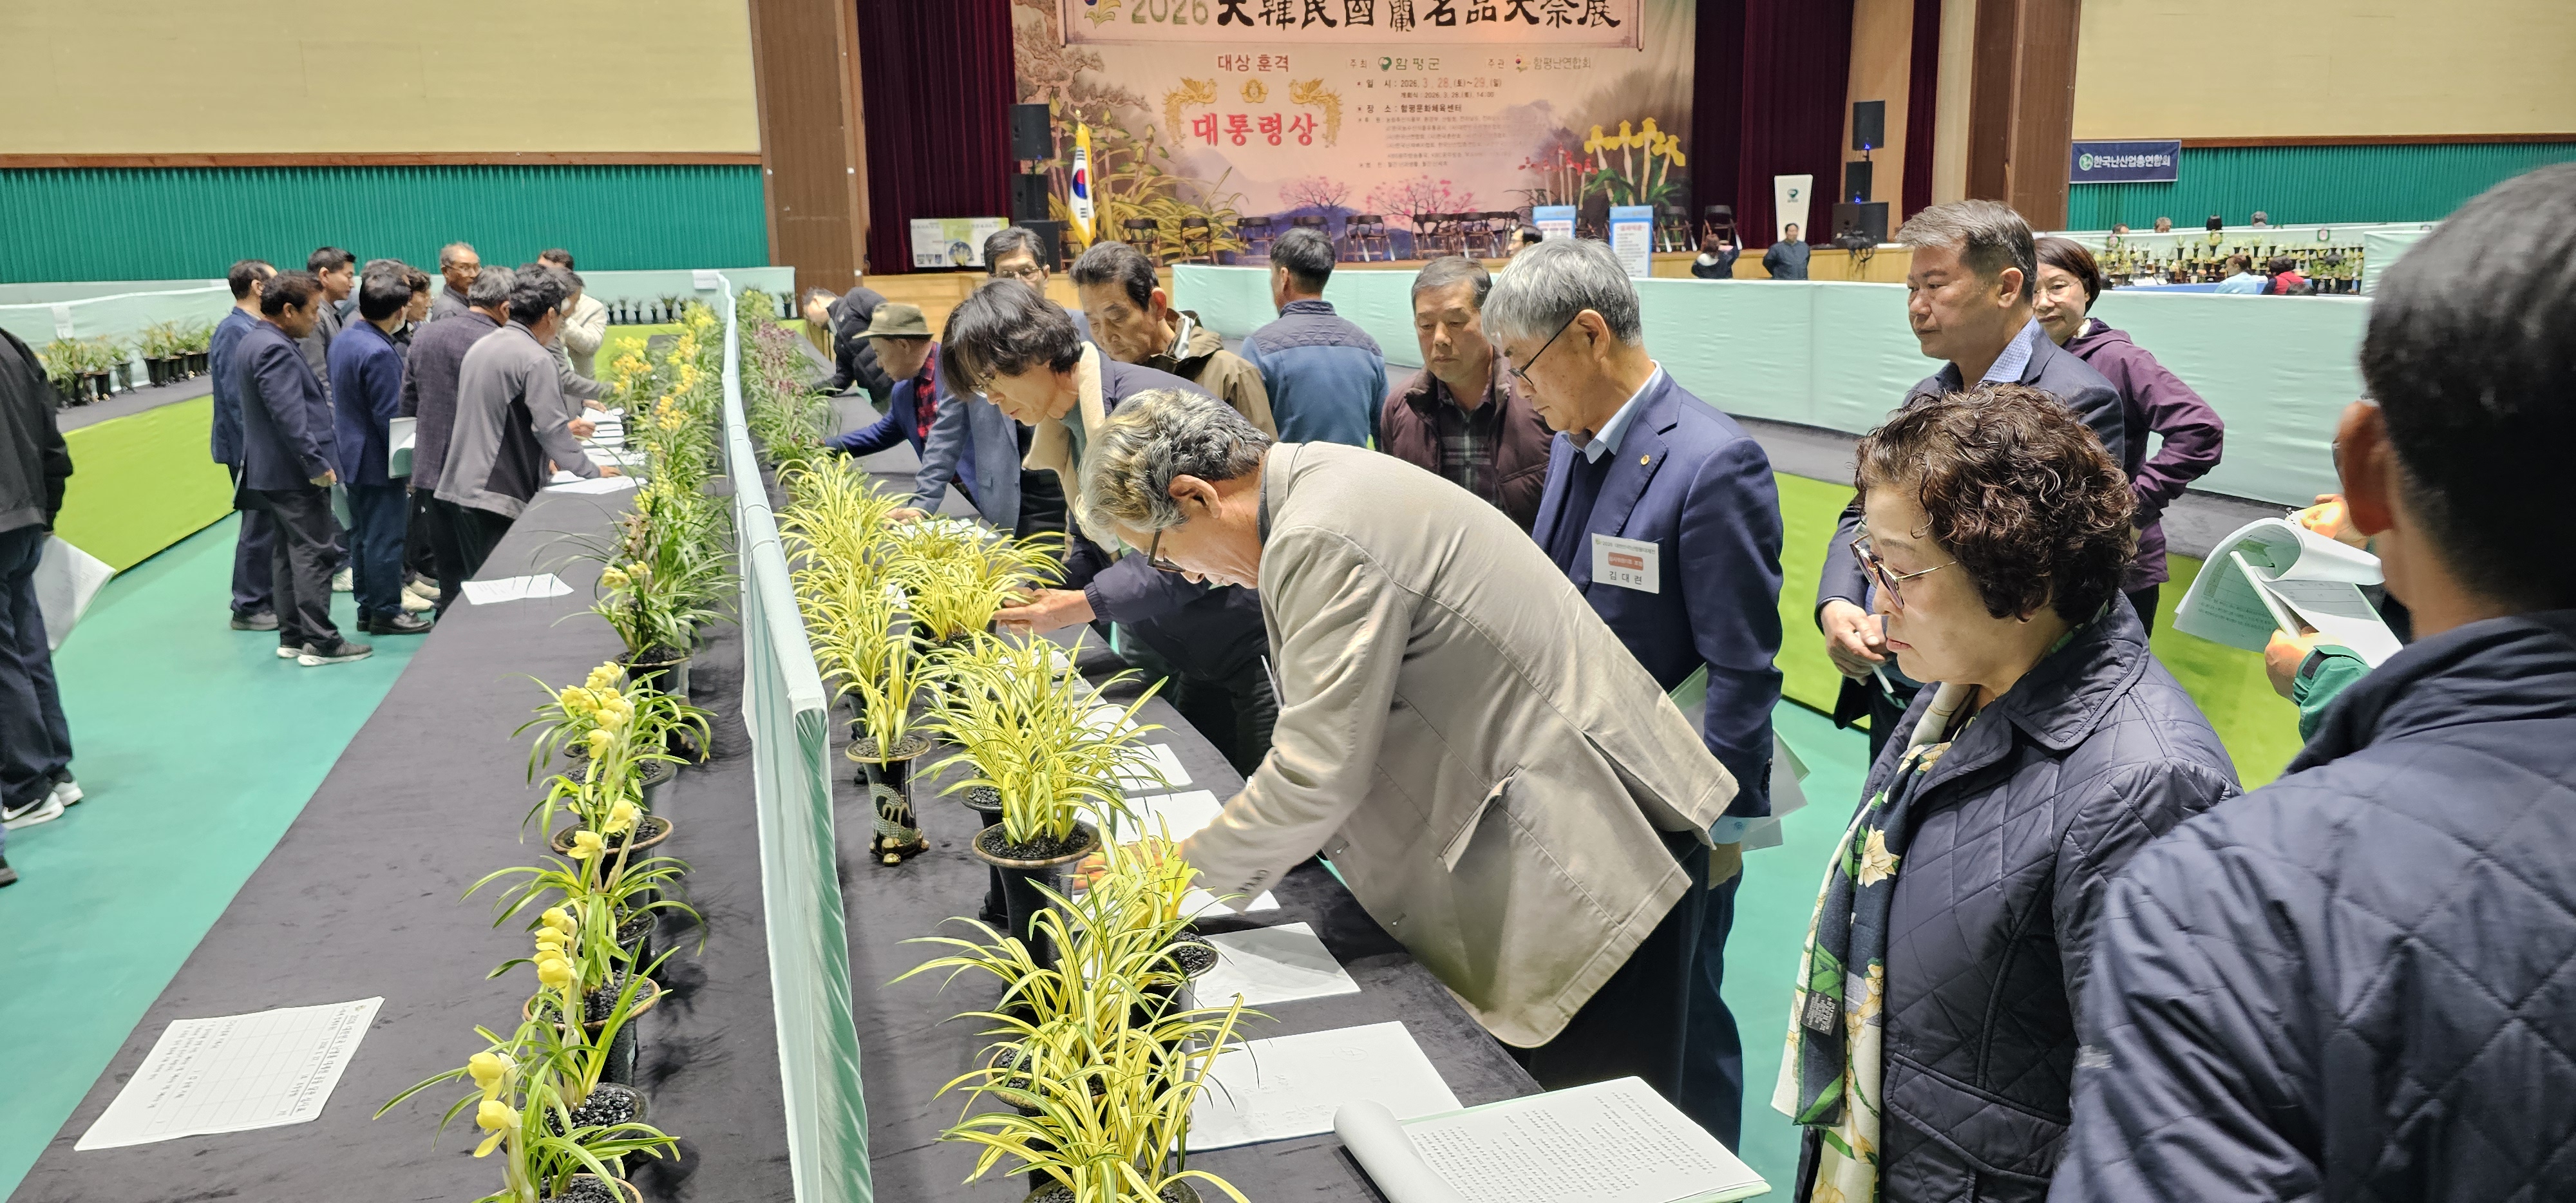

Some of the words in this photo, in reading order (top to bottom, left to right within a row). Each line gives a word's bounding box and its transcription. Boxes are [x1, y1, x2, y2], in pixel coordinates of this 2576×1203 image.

[1131, 0, 1209, 25] 2026
[1218, 54, 1250, 71] 대상
[1256, 54, 1289, 71] 훈격
[1396, 57, 1440, 70] 함평군
[1533, 57, 1591, 70] 함평난연합회
[1401, 104, 1462, 113] 함평문화체육센터
[1191, 113, 1318, 146] 대통령상
